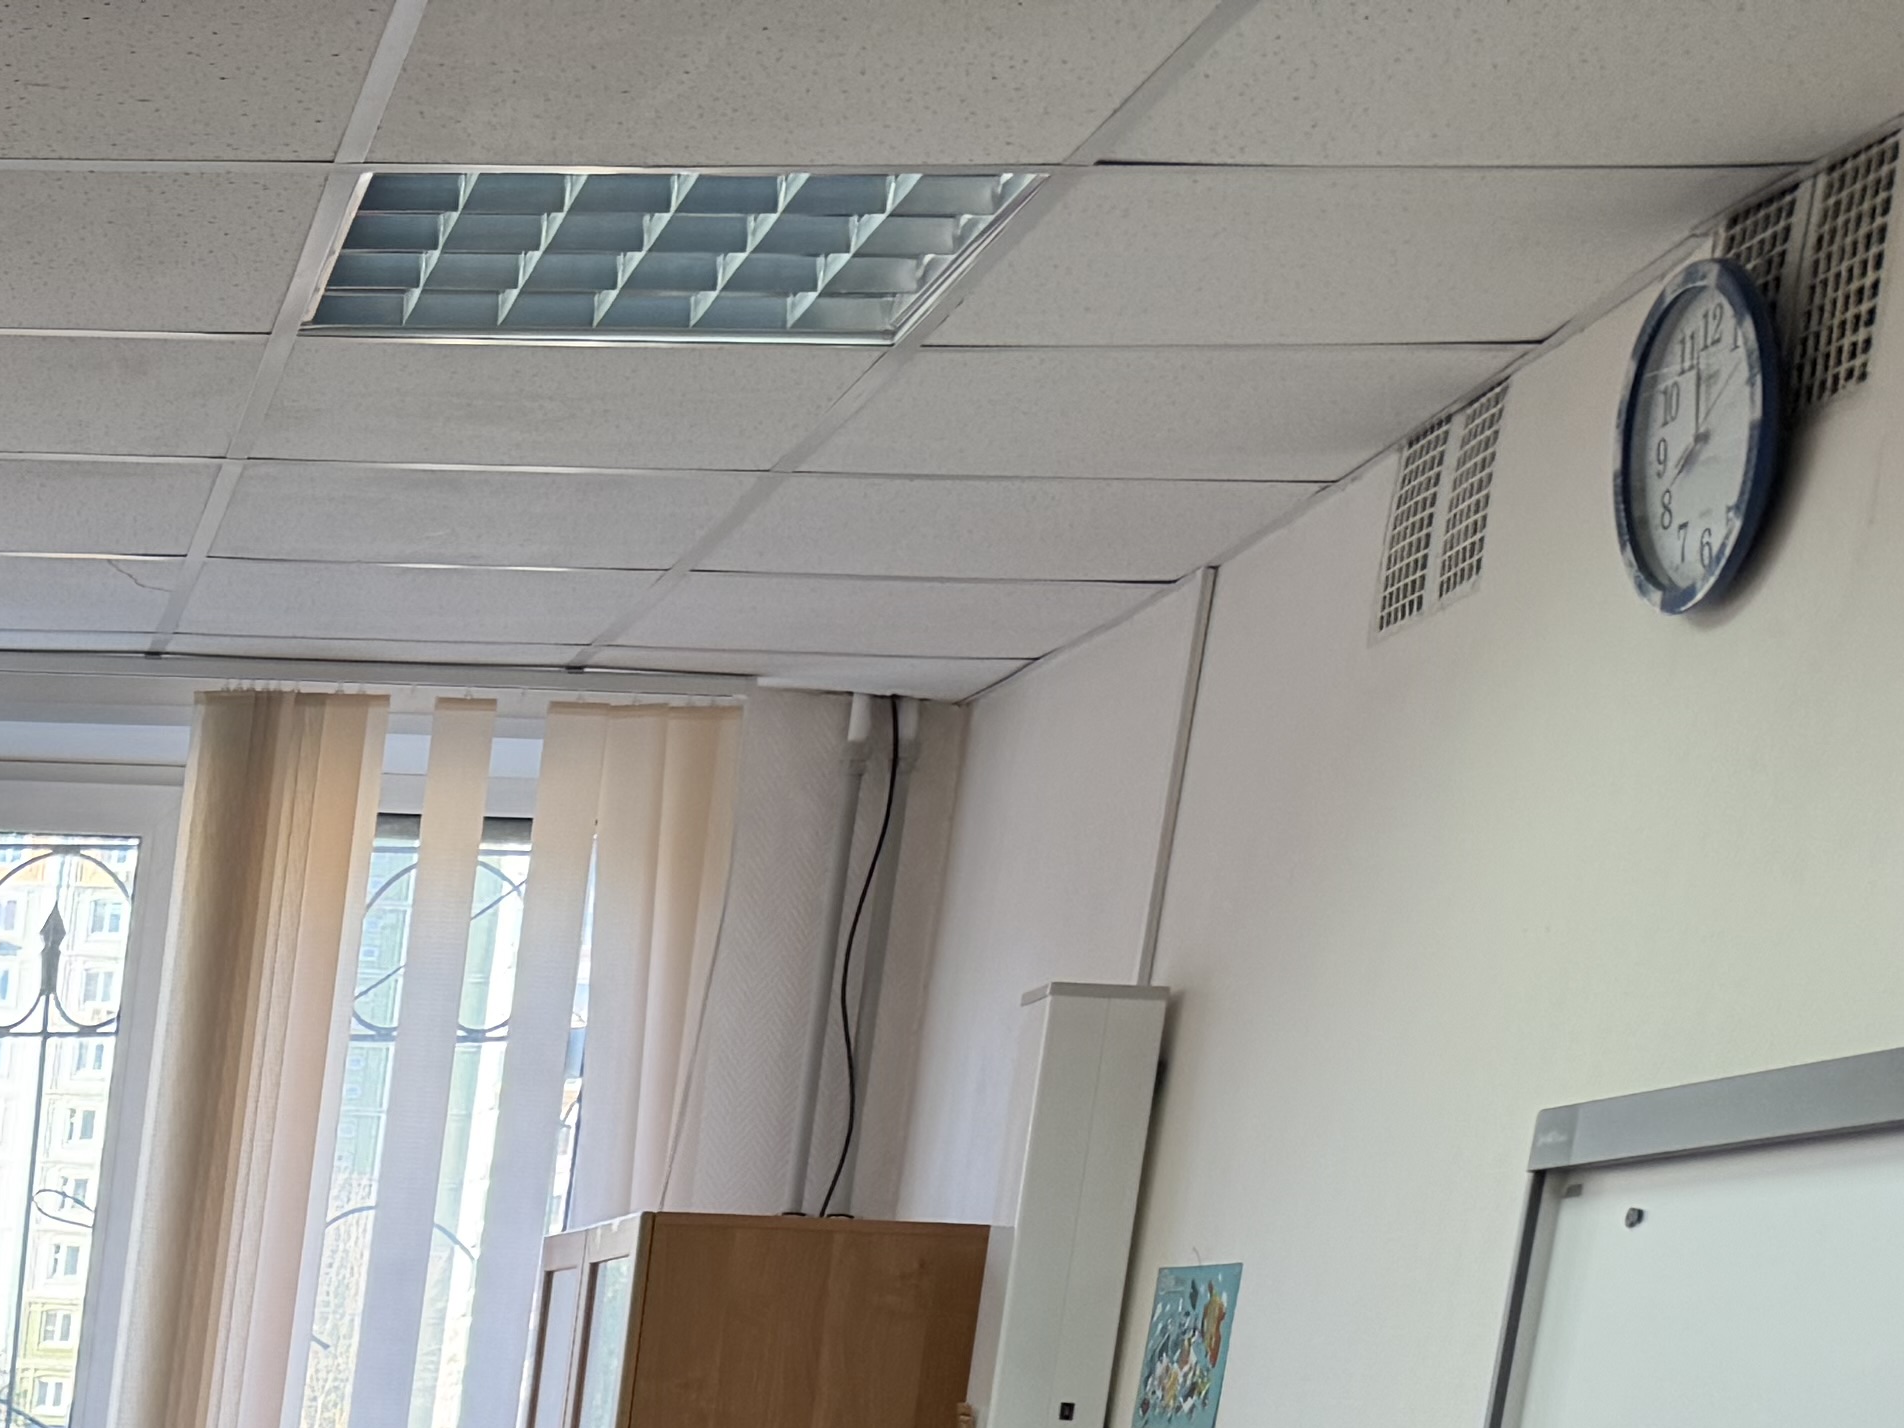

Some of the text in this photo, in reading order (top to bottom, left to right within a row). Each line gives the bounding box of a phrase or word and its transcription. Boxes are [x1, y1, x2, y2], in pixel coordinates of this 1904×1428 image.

[1701, 303, 1723, 351] 12
[1678, 327, 1696, 376] 11
[1660, 380, 1680, 428] 10
[1656, 437, 1669, 479] 9
[1660, 488, 1672, 531] 8
[1677, 521, 1690, 564] 7
[1700, 527, 1713, 569] 6
